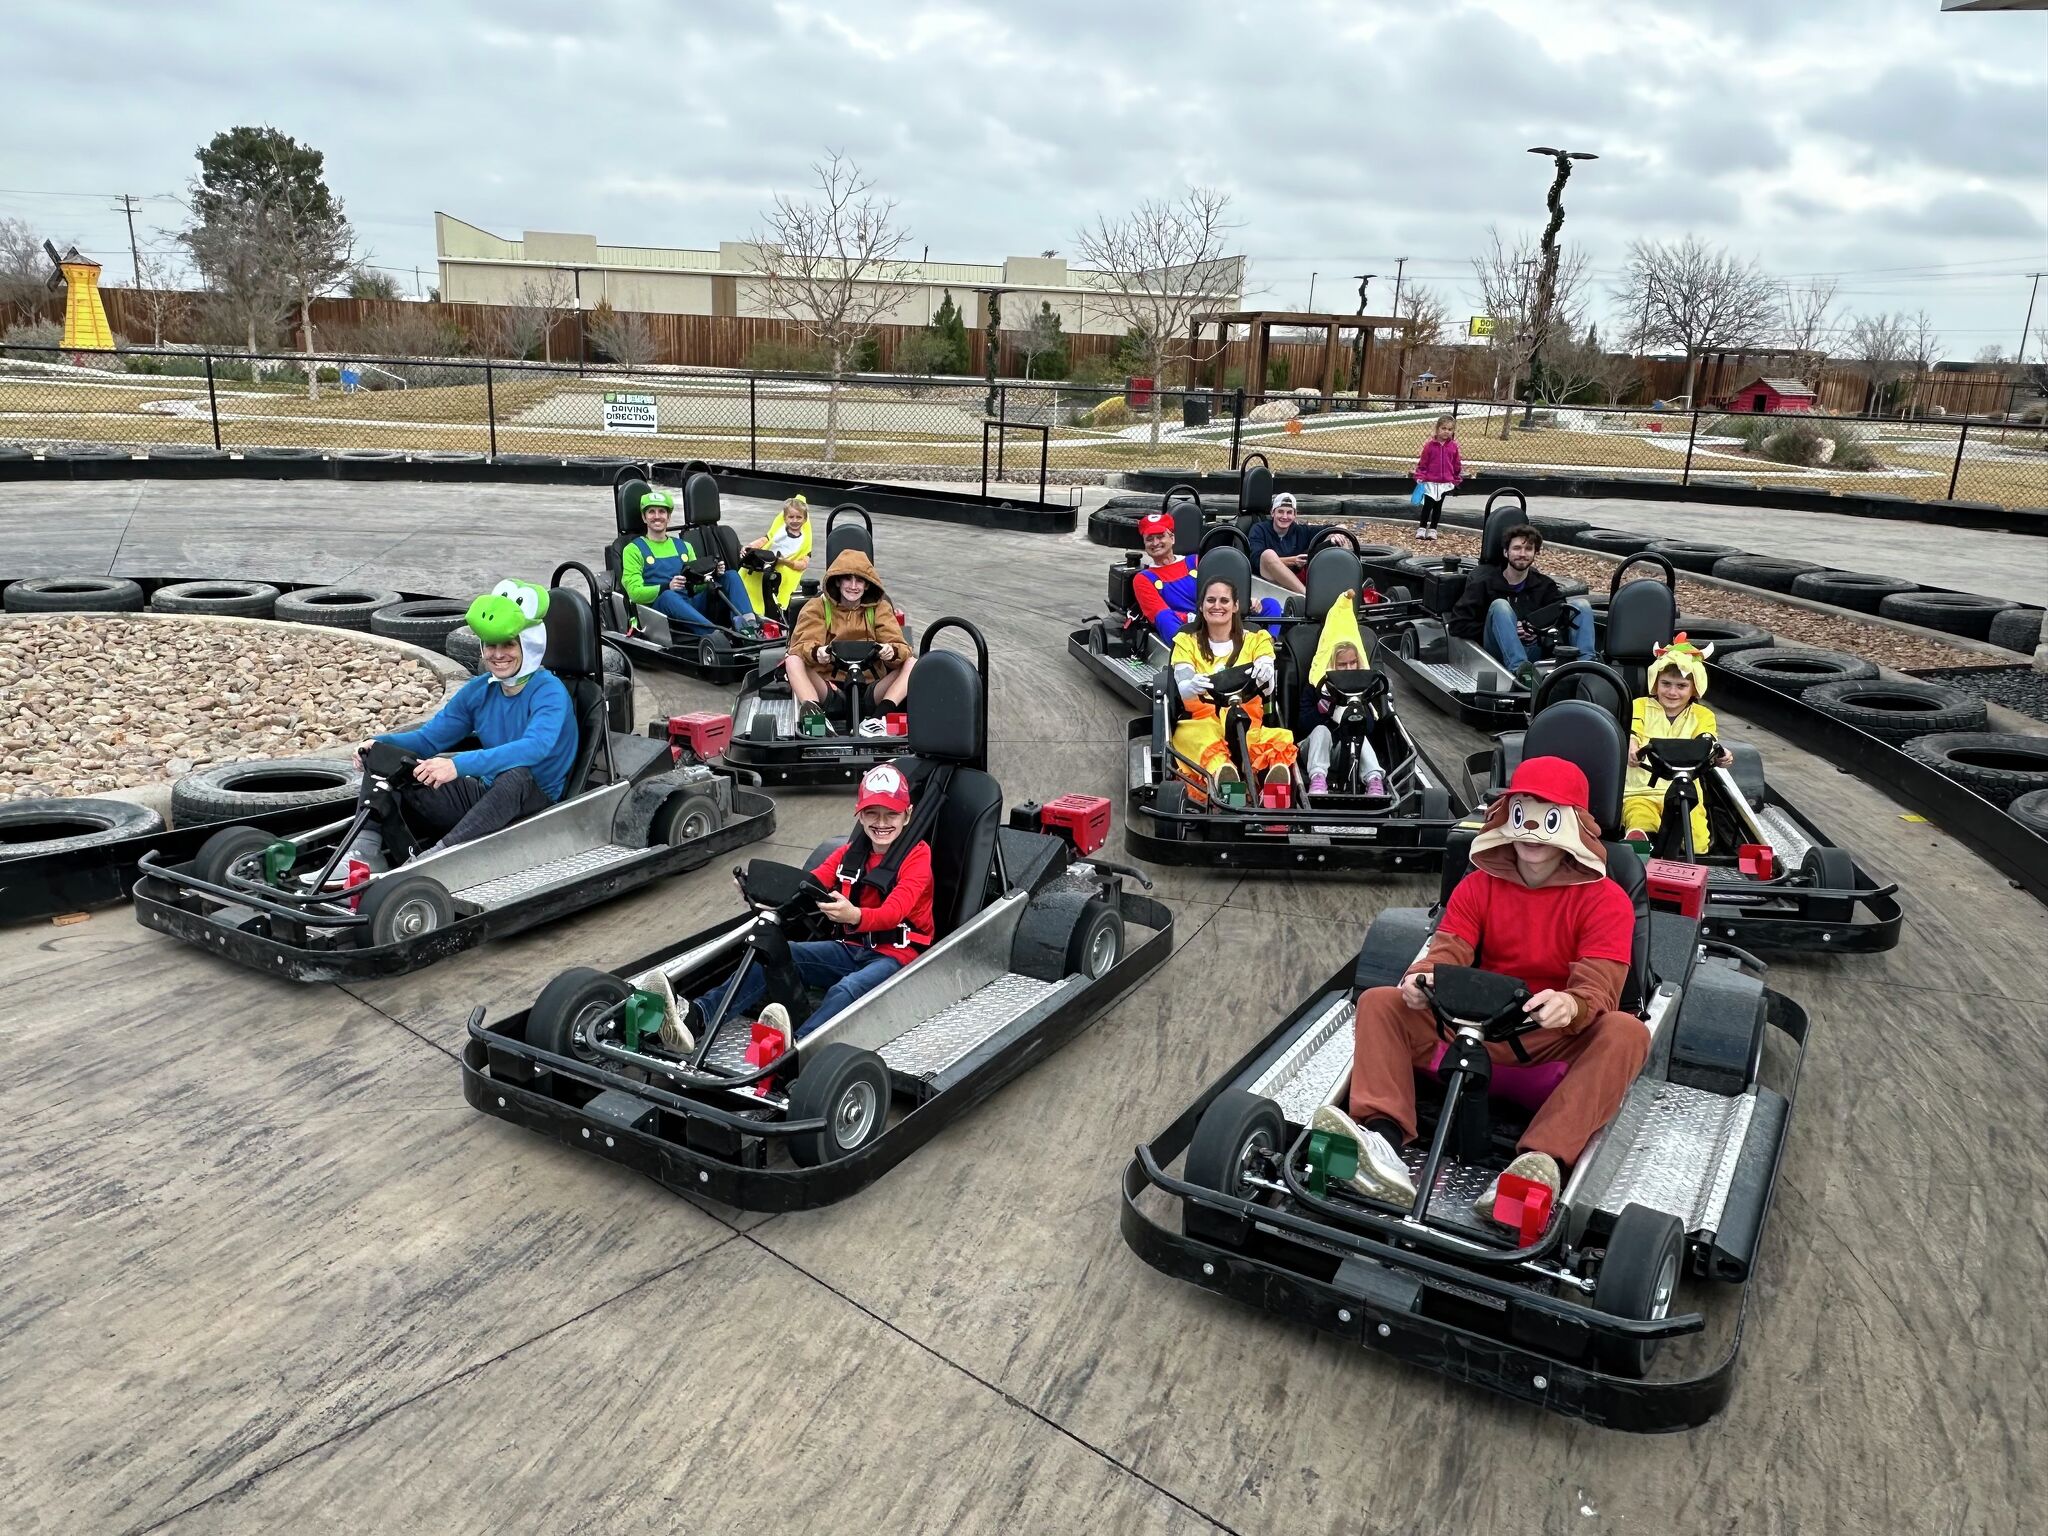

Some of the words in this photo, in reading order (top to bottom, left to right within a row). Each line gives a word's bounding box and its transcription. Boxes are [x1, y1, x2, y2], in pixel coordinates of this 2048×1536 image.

[611, 405, 649, 413] DRIVING
[606, 413, 655, 421] DIRECTION
[869, 773, 890, 783] M
